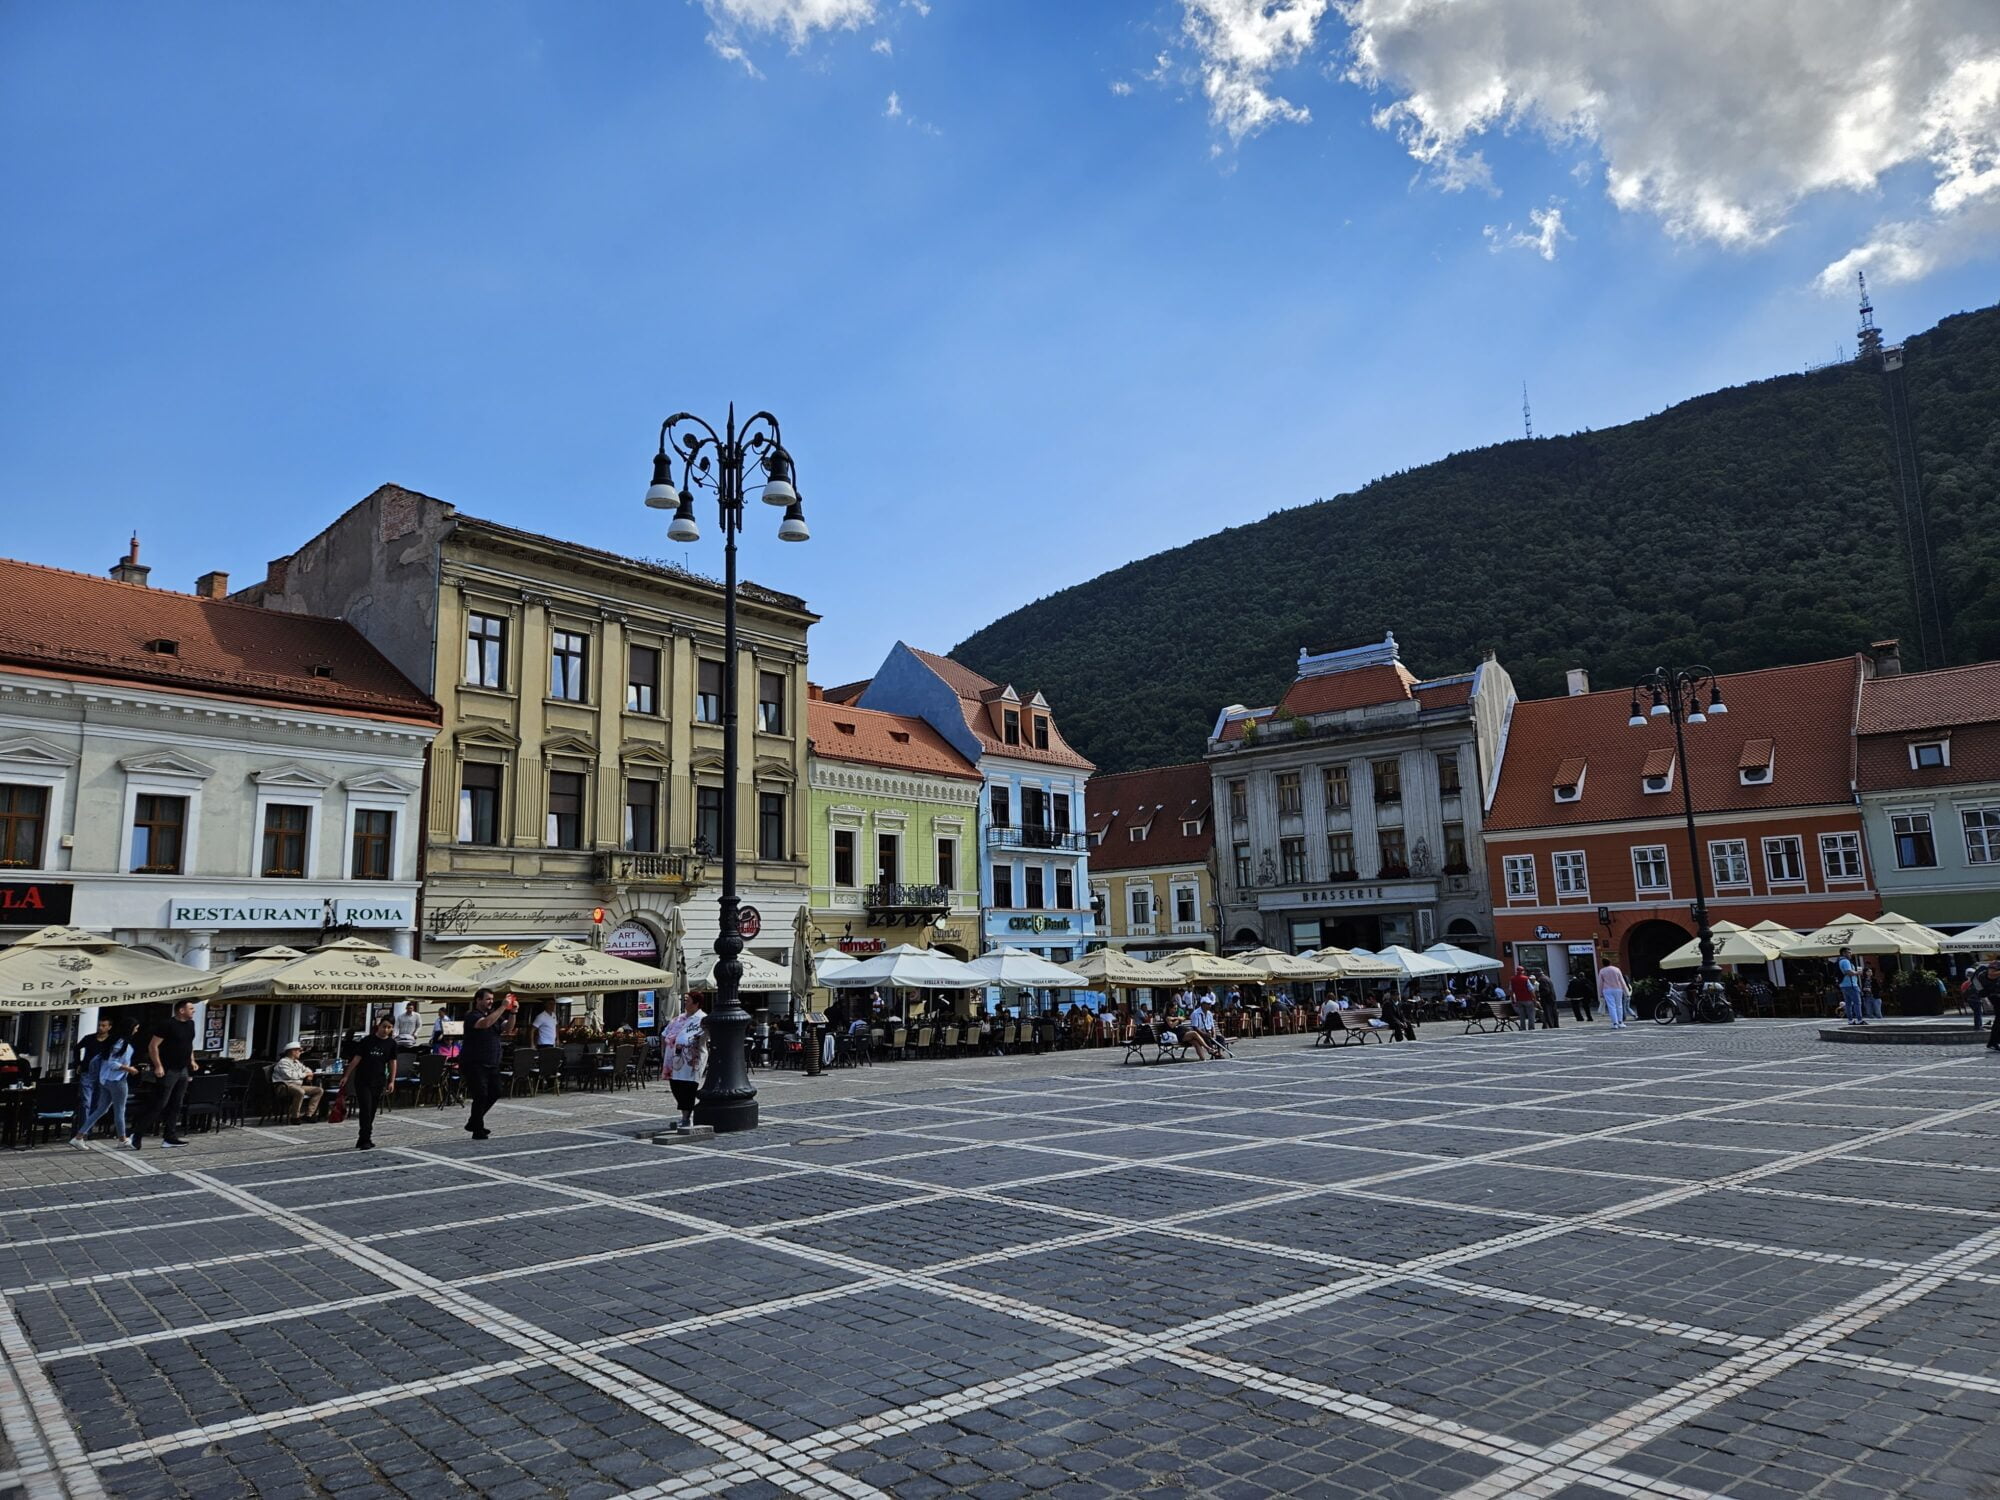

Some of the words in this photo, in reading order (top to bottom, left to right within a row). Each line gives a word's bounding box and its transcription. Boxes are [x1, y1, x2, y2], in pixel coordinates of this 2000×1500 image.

[0, 886, 45, 909] LA
[1302, 887, 1383, 902] BRASSERIE
[175, 907, 321, 921] RESTAURANT
[346, 908, 403, 921] ROMA
[1008, 917, 1032, 931] CEC
[1044, 916, 1071, 931] Bank
[618, 931, 637, 939] ART
[605, 941, 651, 949] GALLERY
[313, 969, 438, 979] KRONSTADT
[331, 983, 363, 991] REGELE
[366, 984, 412, 993] ORAȘELOR
[414, 983, 424, 992] ÎN
[426, 984, 469, 993] ROMÂNIA.
[621, 978, 629, 986] ÎN
[51, 995, 118, 1007] ORAȘELOR
[122, 992, 136, 1001] ÎN
[140, 985, 203, 999] ROMÂNIA.
